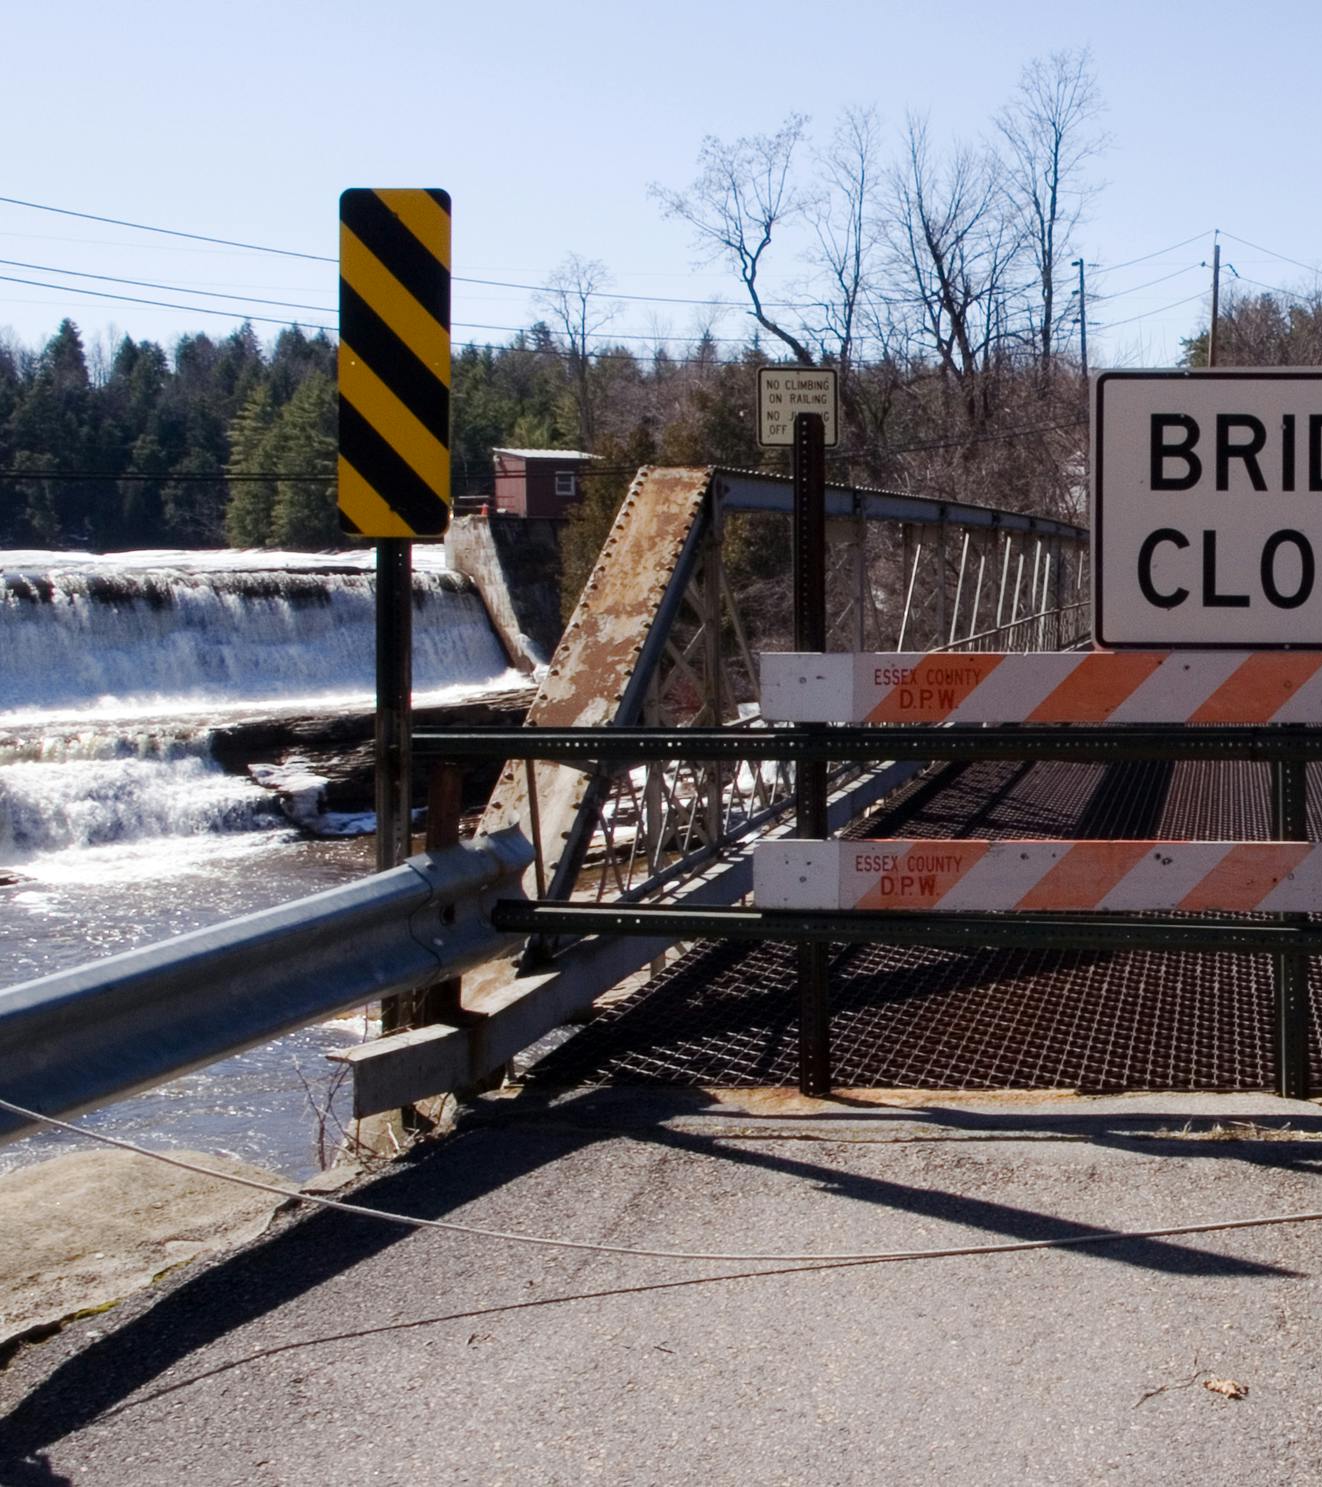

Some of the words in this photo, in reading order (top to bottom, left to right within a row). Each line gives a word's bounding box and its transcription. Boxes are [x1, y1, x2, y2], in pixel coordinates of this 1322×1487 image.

[766, 380, 780, 390] NO
[785, 380, 830, 390] CLIMBING
[769, 394, 782, 404] ON
[789, 394, 828, 404] RAILING
[767, 411, 780, 421] NO
[769, 425, 788, 435] OFF
[874, 668, 918, 686] ESSEX
[926, 668, 982, 686] COUNTY
[855, 855, 899, 872] ESSEX
[906, 855, 963, 873] COUNTY
